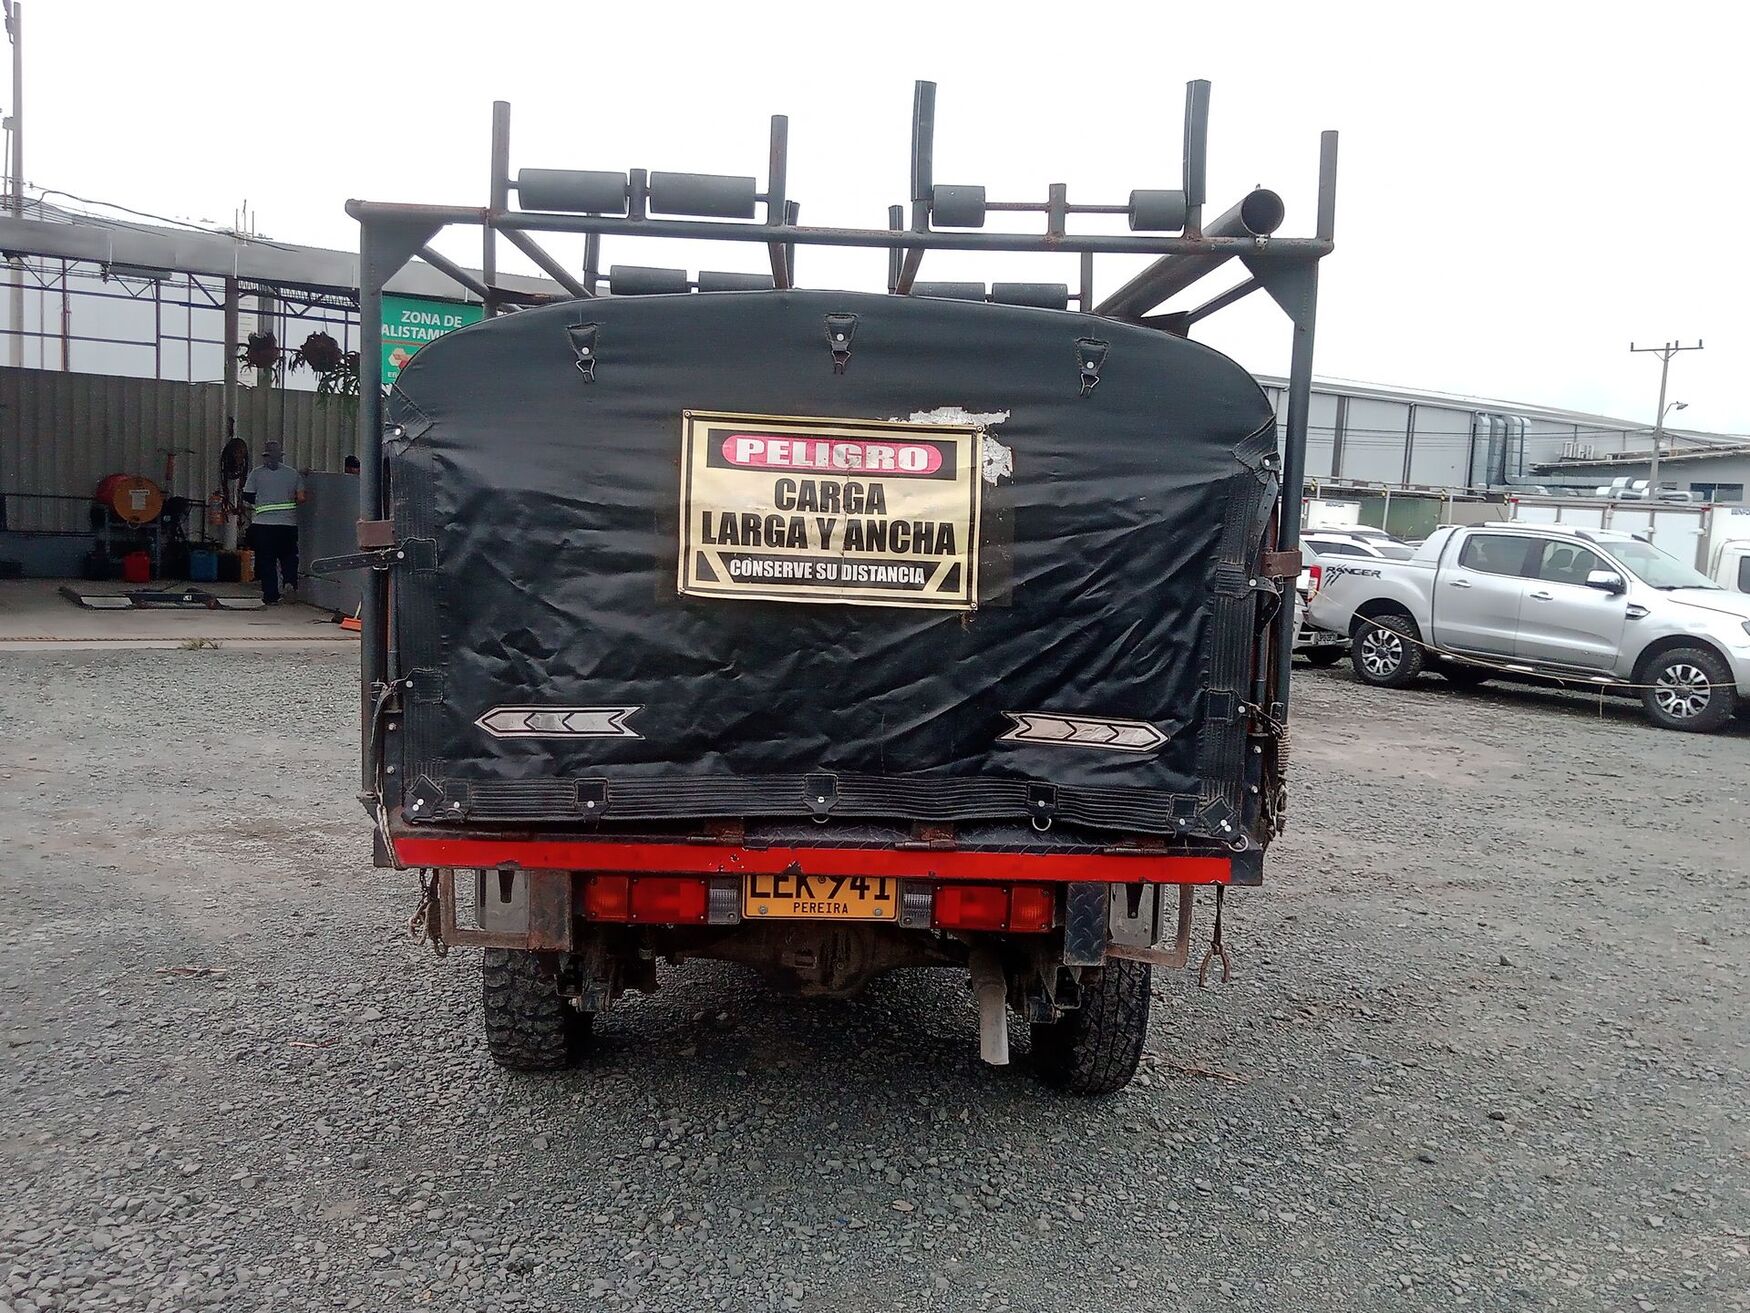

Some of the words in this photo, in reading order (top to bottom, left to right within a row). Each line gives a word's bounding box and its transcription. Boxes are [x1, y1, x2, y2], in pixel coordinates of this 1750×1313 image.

[401, 310, 441, 326] ZONA
[444, 315, 463, 328] DE
[735, 438, 929, 471] PELIGRO
[774, 478, 887, 515] CARGA
[702, 511, 808, 549] LARGA
[815, 517, 838, 551] Y
[844, 519, 957, 556] ANCHA
[729, 558, 813, 580] CONSERVE
[815, 562, 837, 581] SU
[841, 564, 925, 584] DISTANCIA
[1325, 565, 1381, 579] RANGER
[793, 901, 848, 914] PEREIRA
